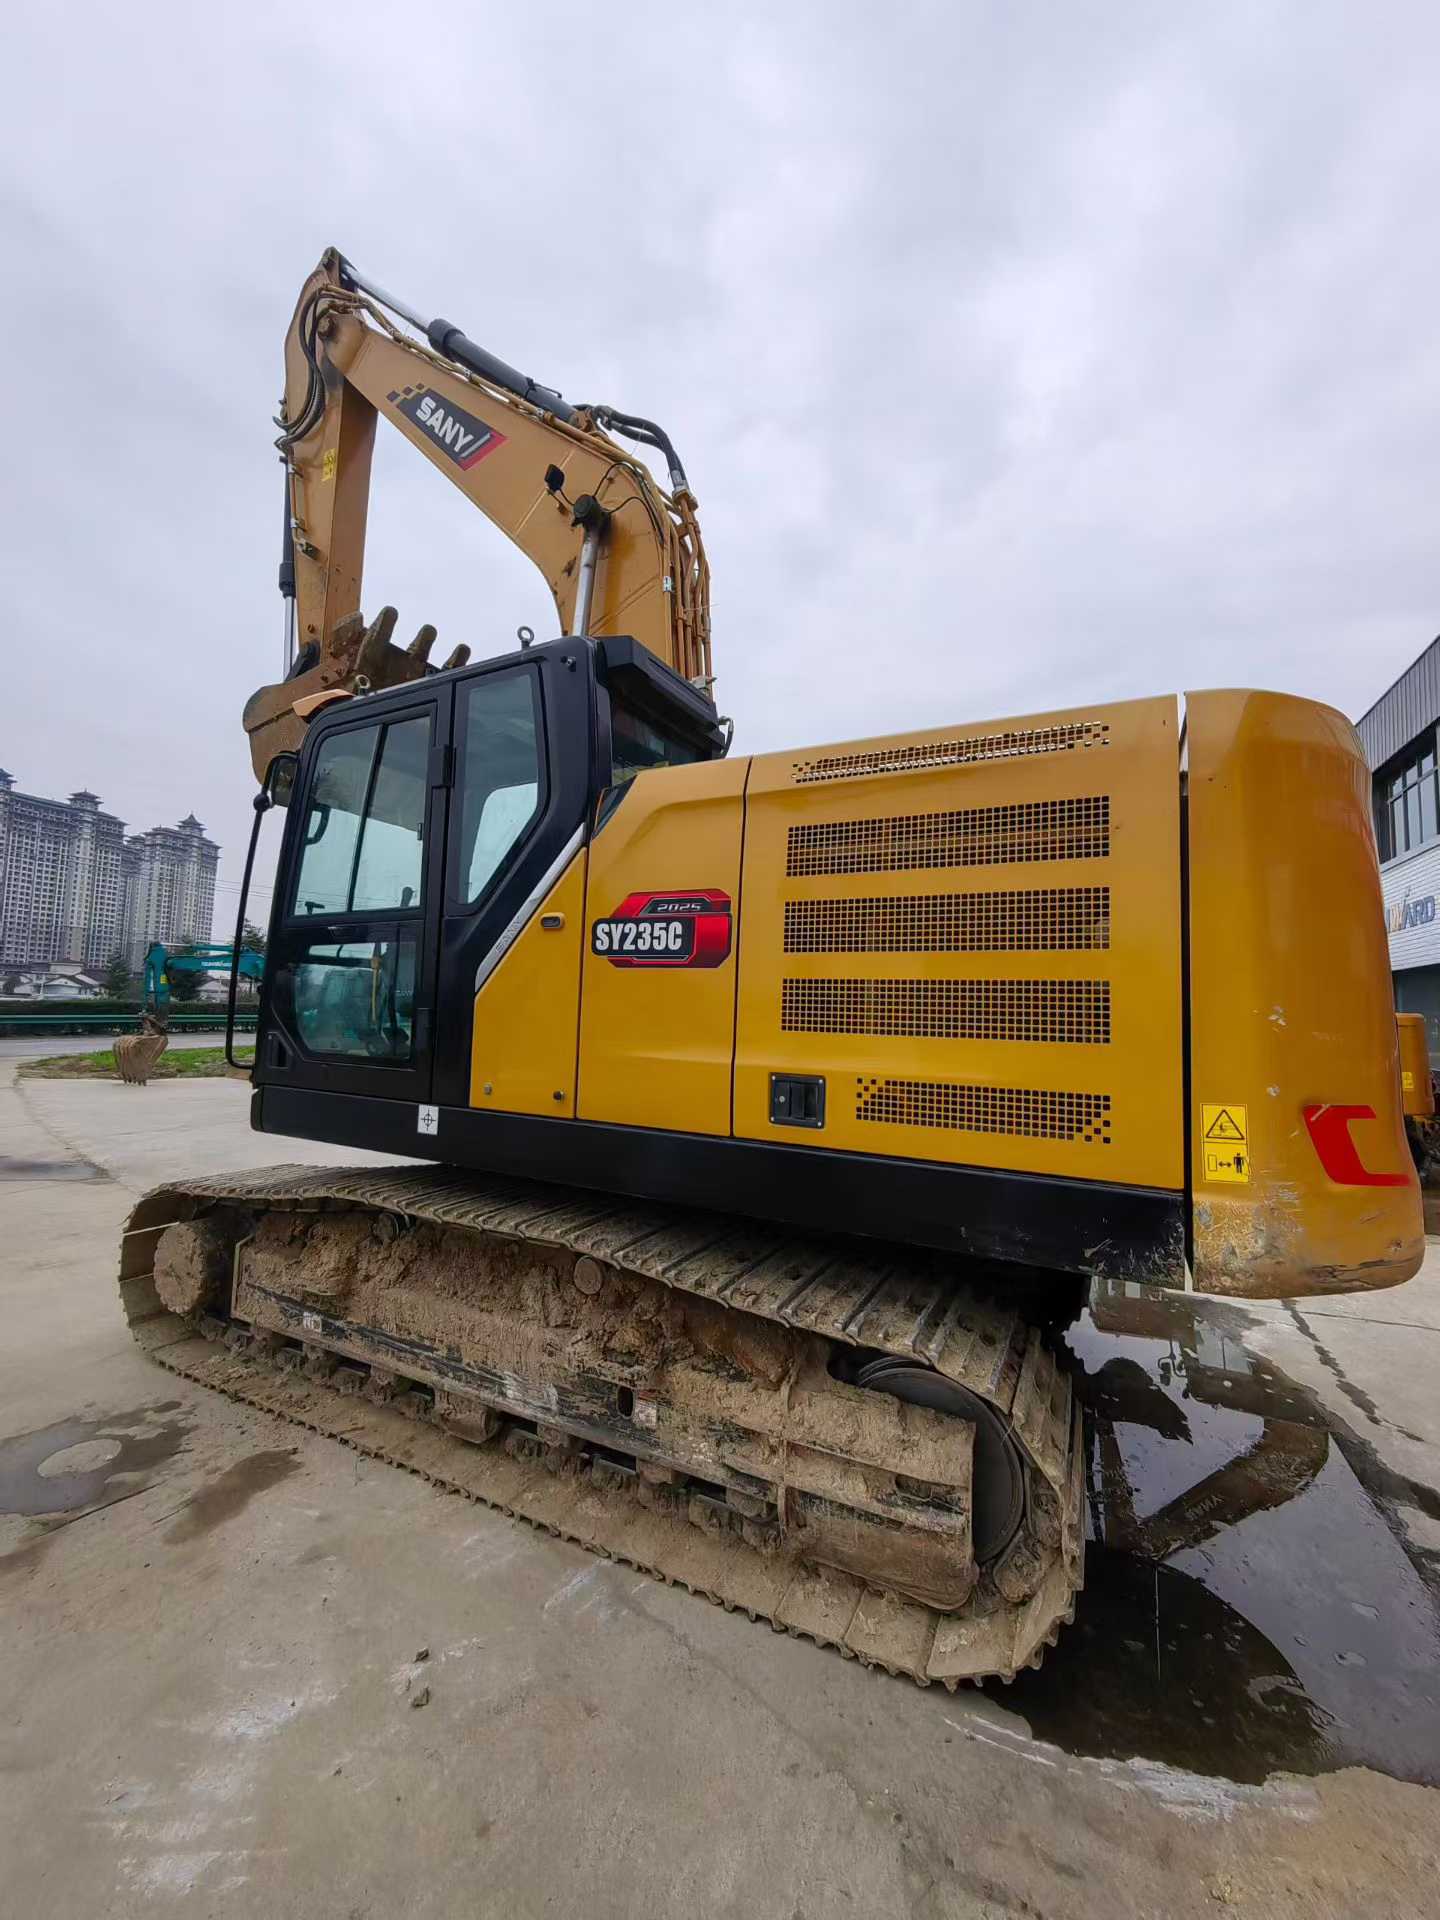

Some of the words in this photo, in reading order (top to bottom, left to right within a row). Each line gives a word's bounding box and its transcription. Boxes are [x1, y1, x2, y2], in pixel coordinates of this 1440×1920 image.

[416, 396, 473, 453] SANY
[656, 902, 704, 913] 2025
[1385, 896, 1436, 934] WARD
[595, 921, 683, 951] SY235C
